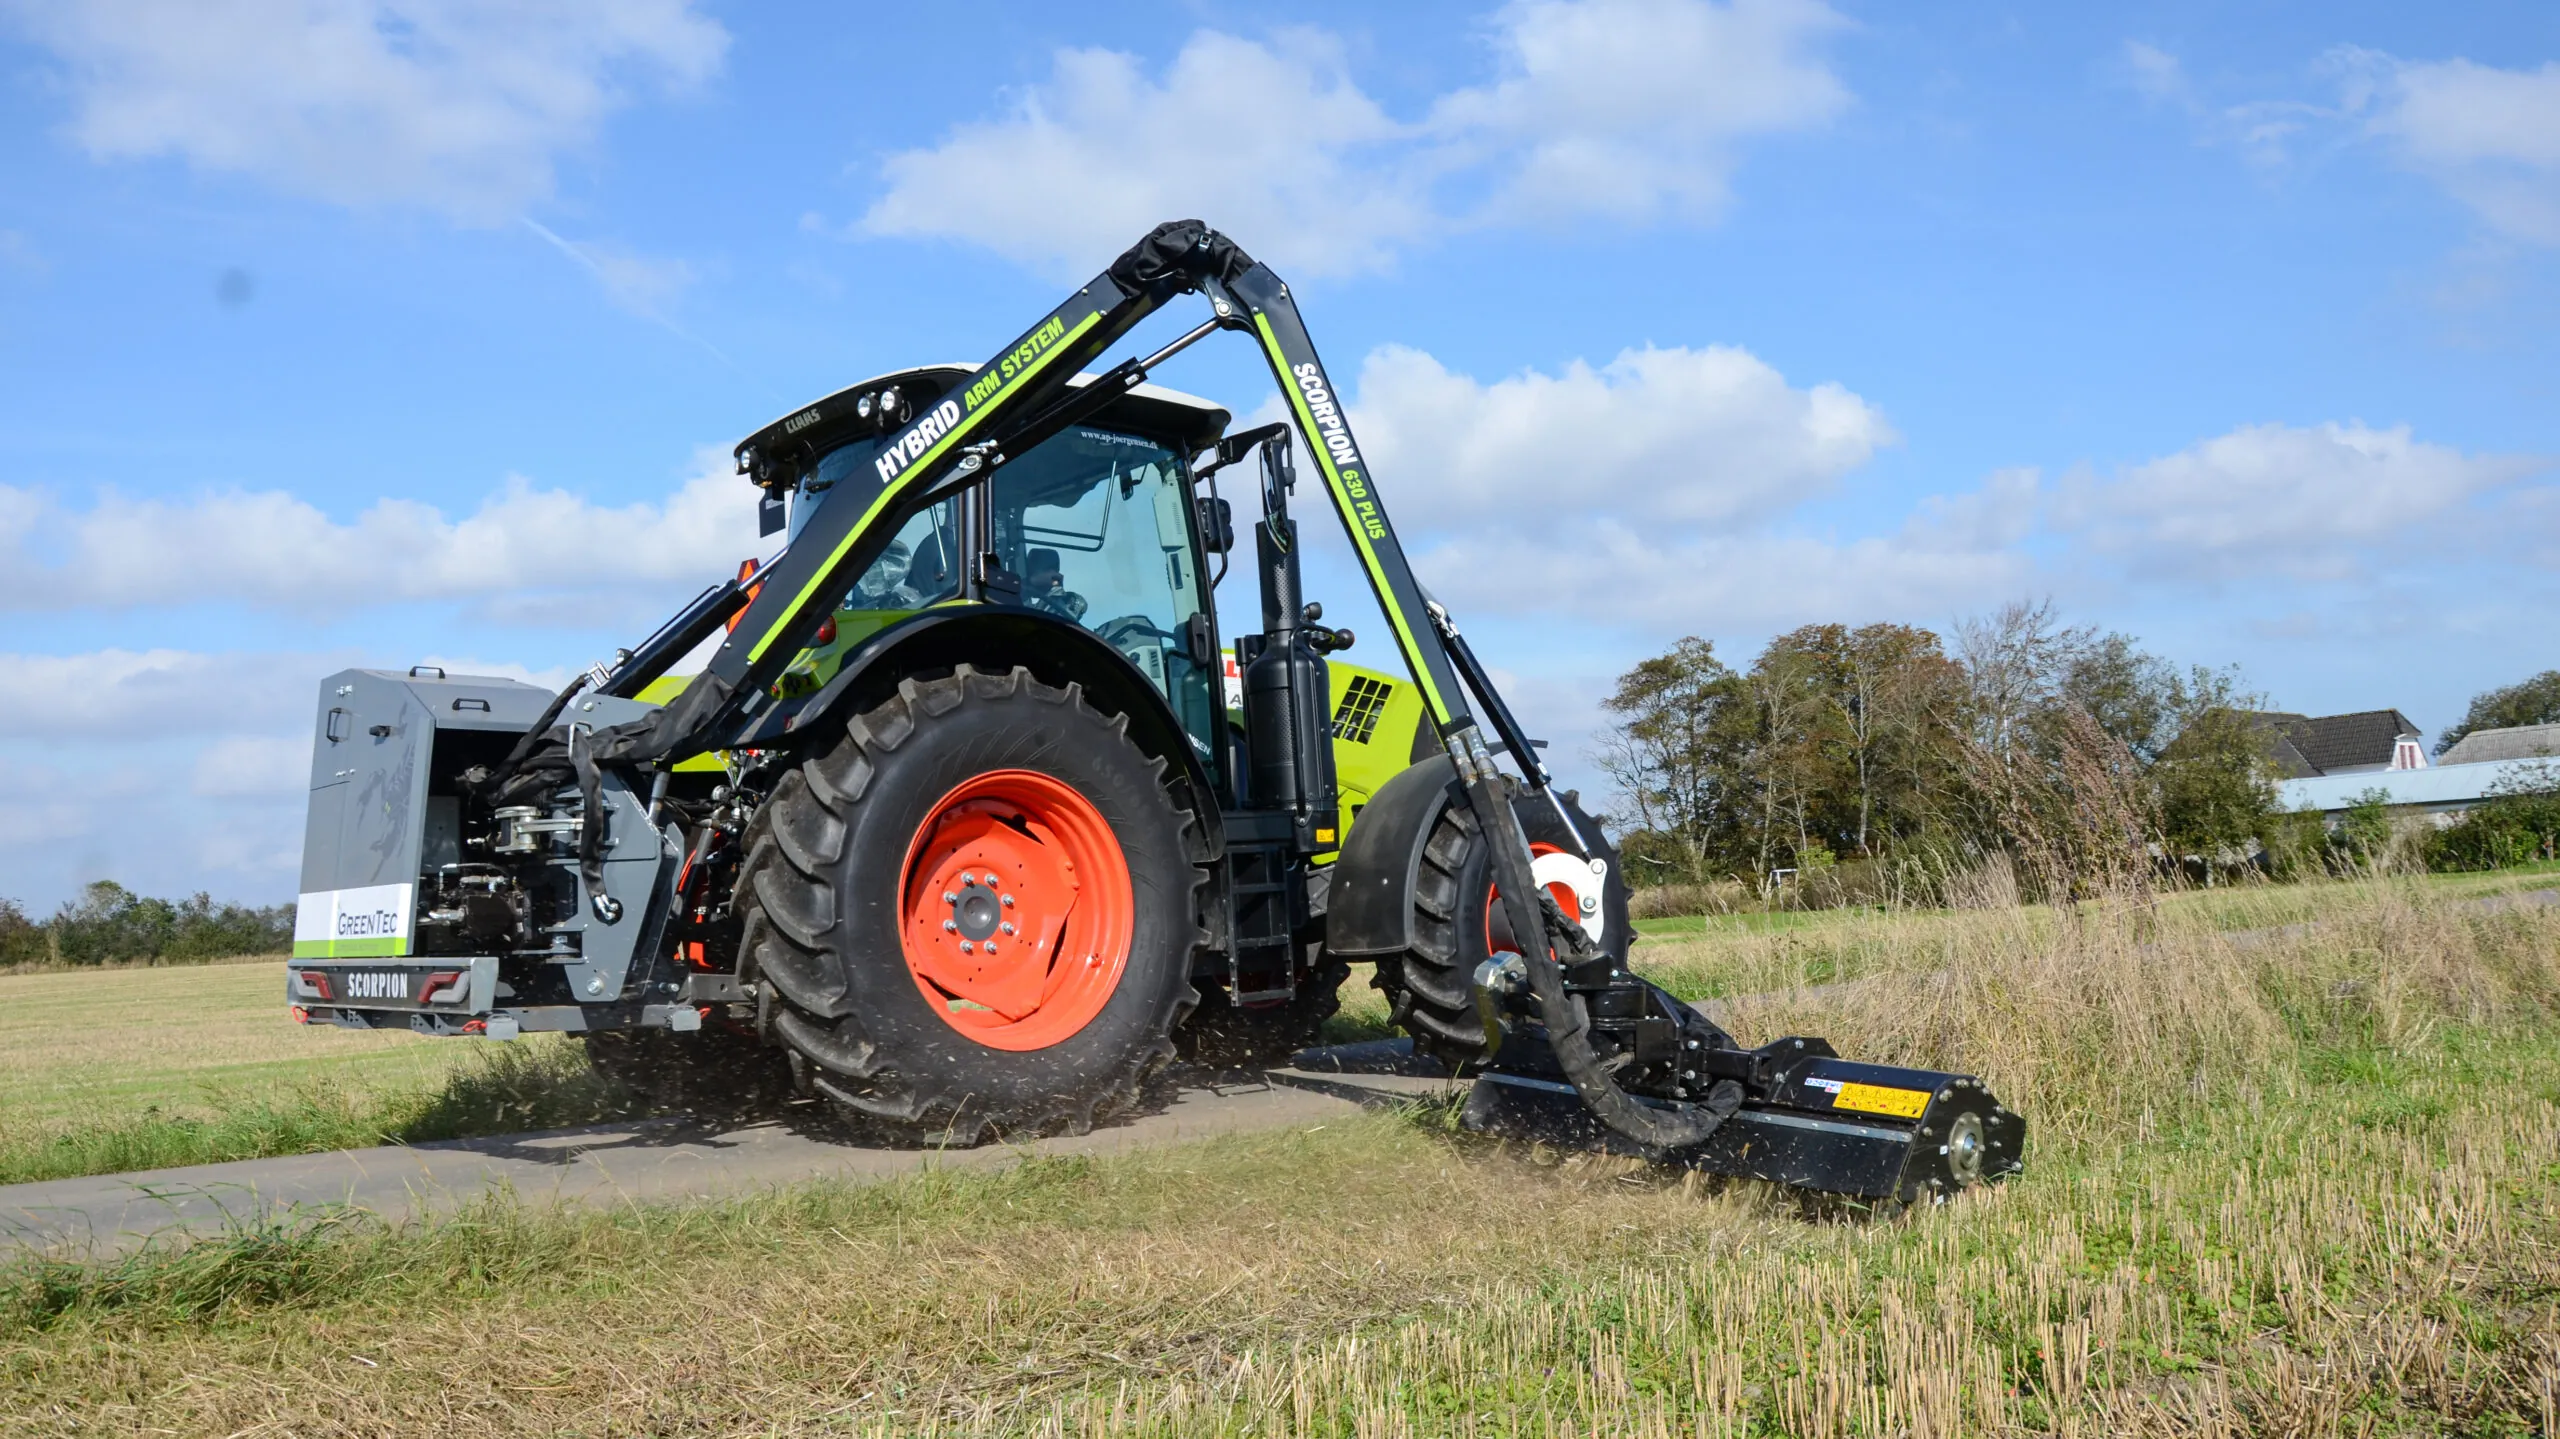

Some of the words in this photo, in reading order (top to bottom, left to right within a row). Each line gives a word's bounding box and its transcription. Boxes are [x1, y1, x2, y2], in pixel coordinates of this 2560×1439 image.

[785, 408, 821, 434] CLAAS
[875, 400, 960, 483] HYBRID
[964, 370, 1001, 411] ARM
[1000, 316, 1064, 378] SYSTEM
[1294, 363, 1358, 465] SCORPION
[1342, 469, 1367, 498] 630
[1356, 501, 1386, 540] PLUS
[348, 972, 408, 998] SCORPION
